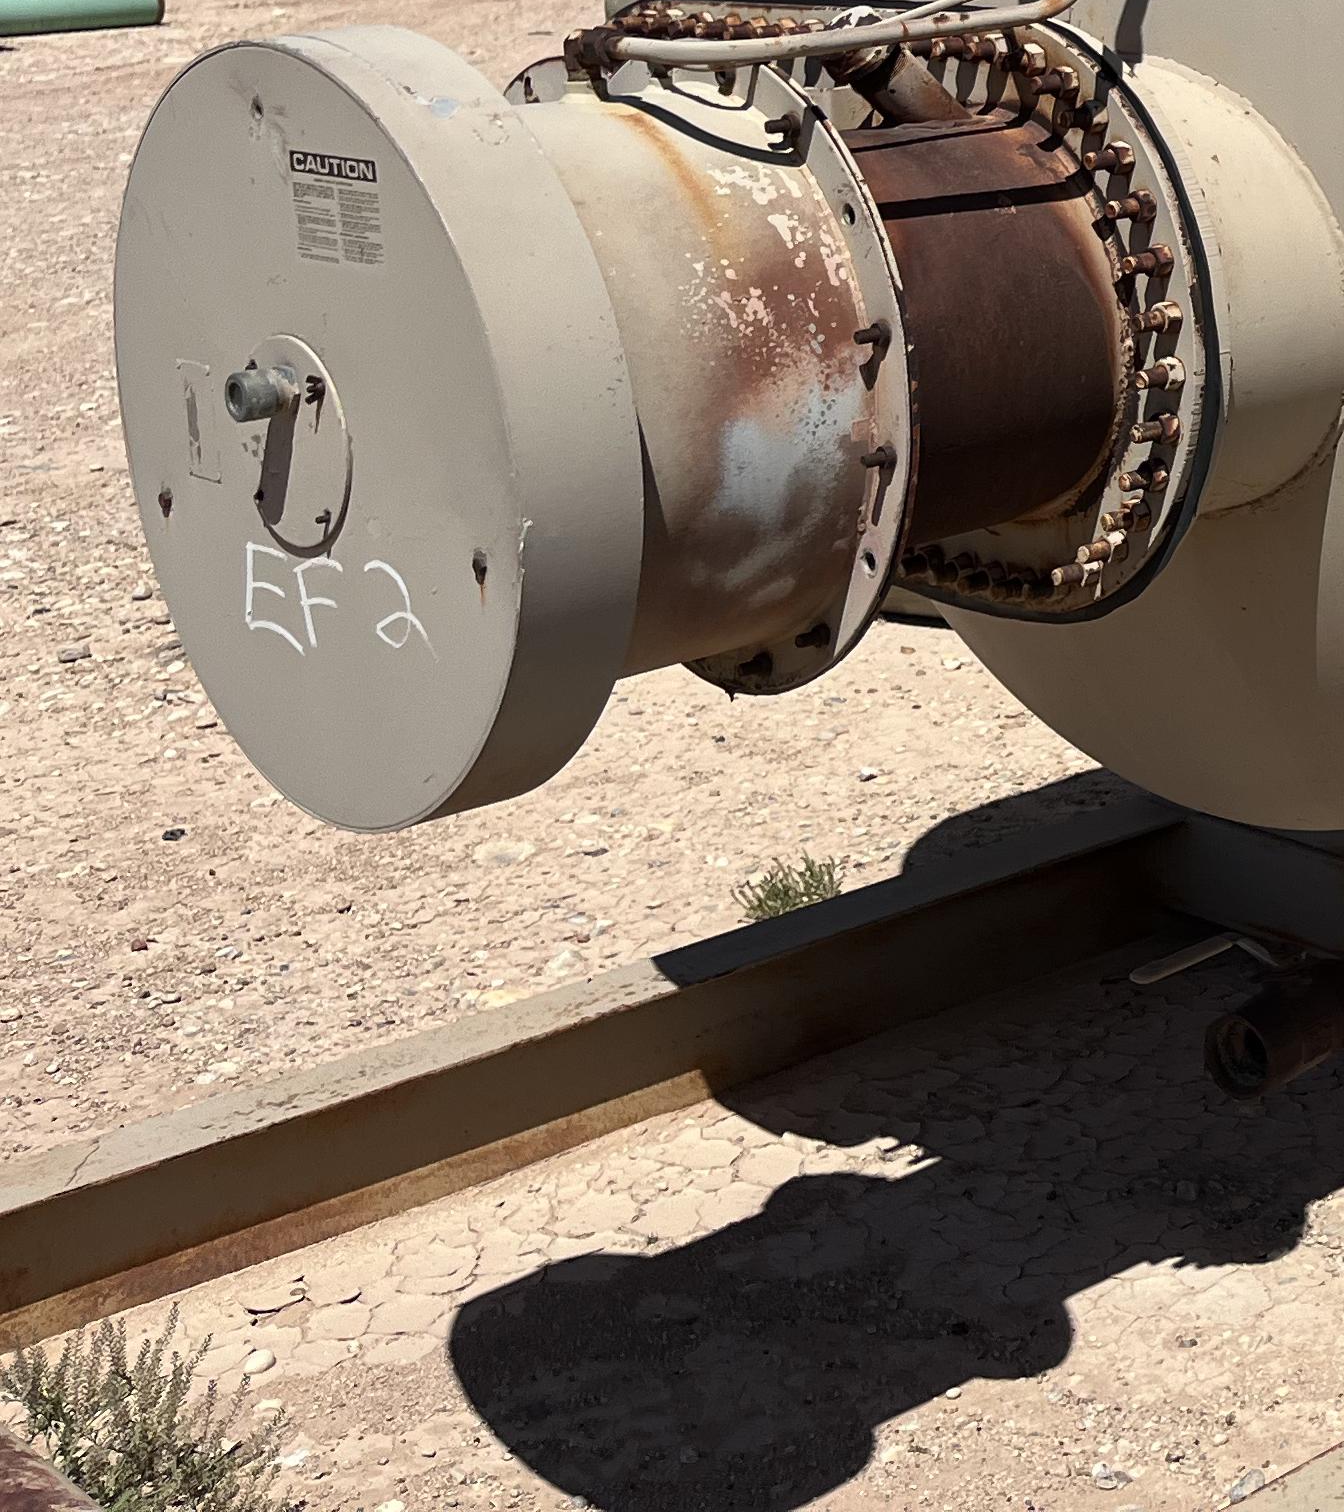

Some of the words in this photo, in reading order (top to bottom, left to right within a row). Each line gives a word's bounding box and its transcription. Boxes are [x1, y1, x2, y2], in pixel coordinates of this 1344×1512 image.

[293, 153, 374, 180] CAUTION
[243, 541, 344, 656] EF
[363, 560, 439, 661] 2
